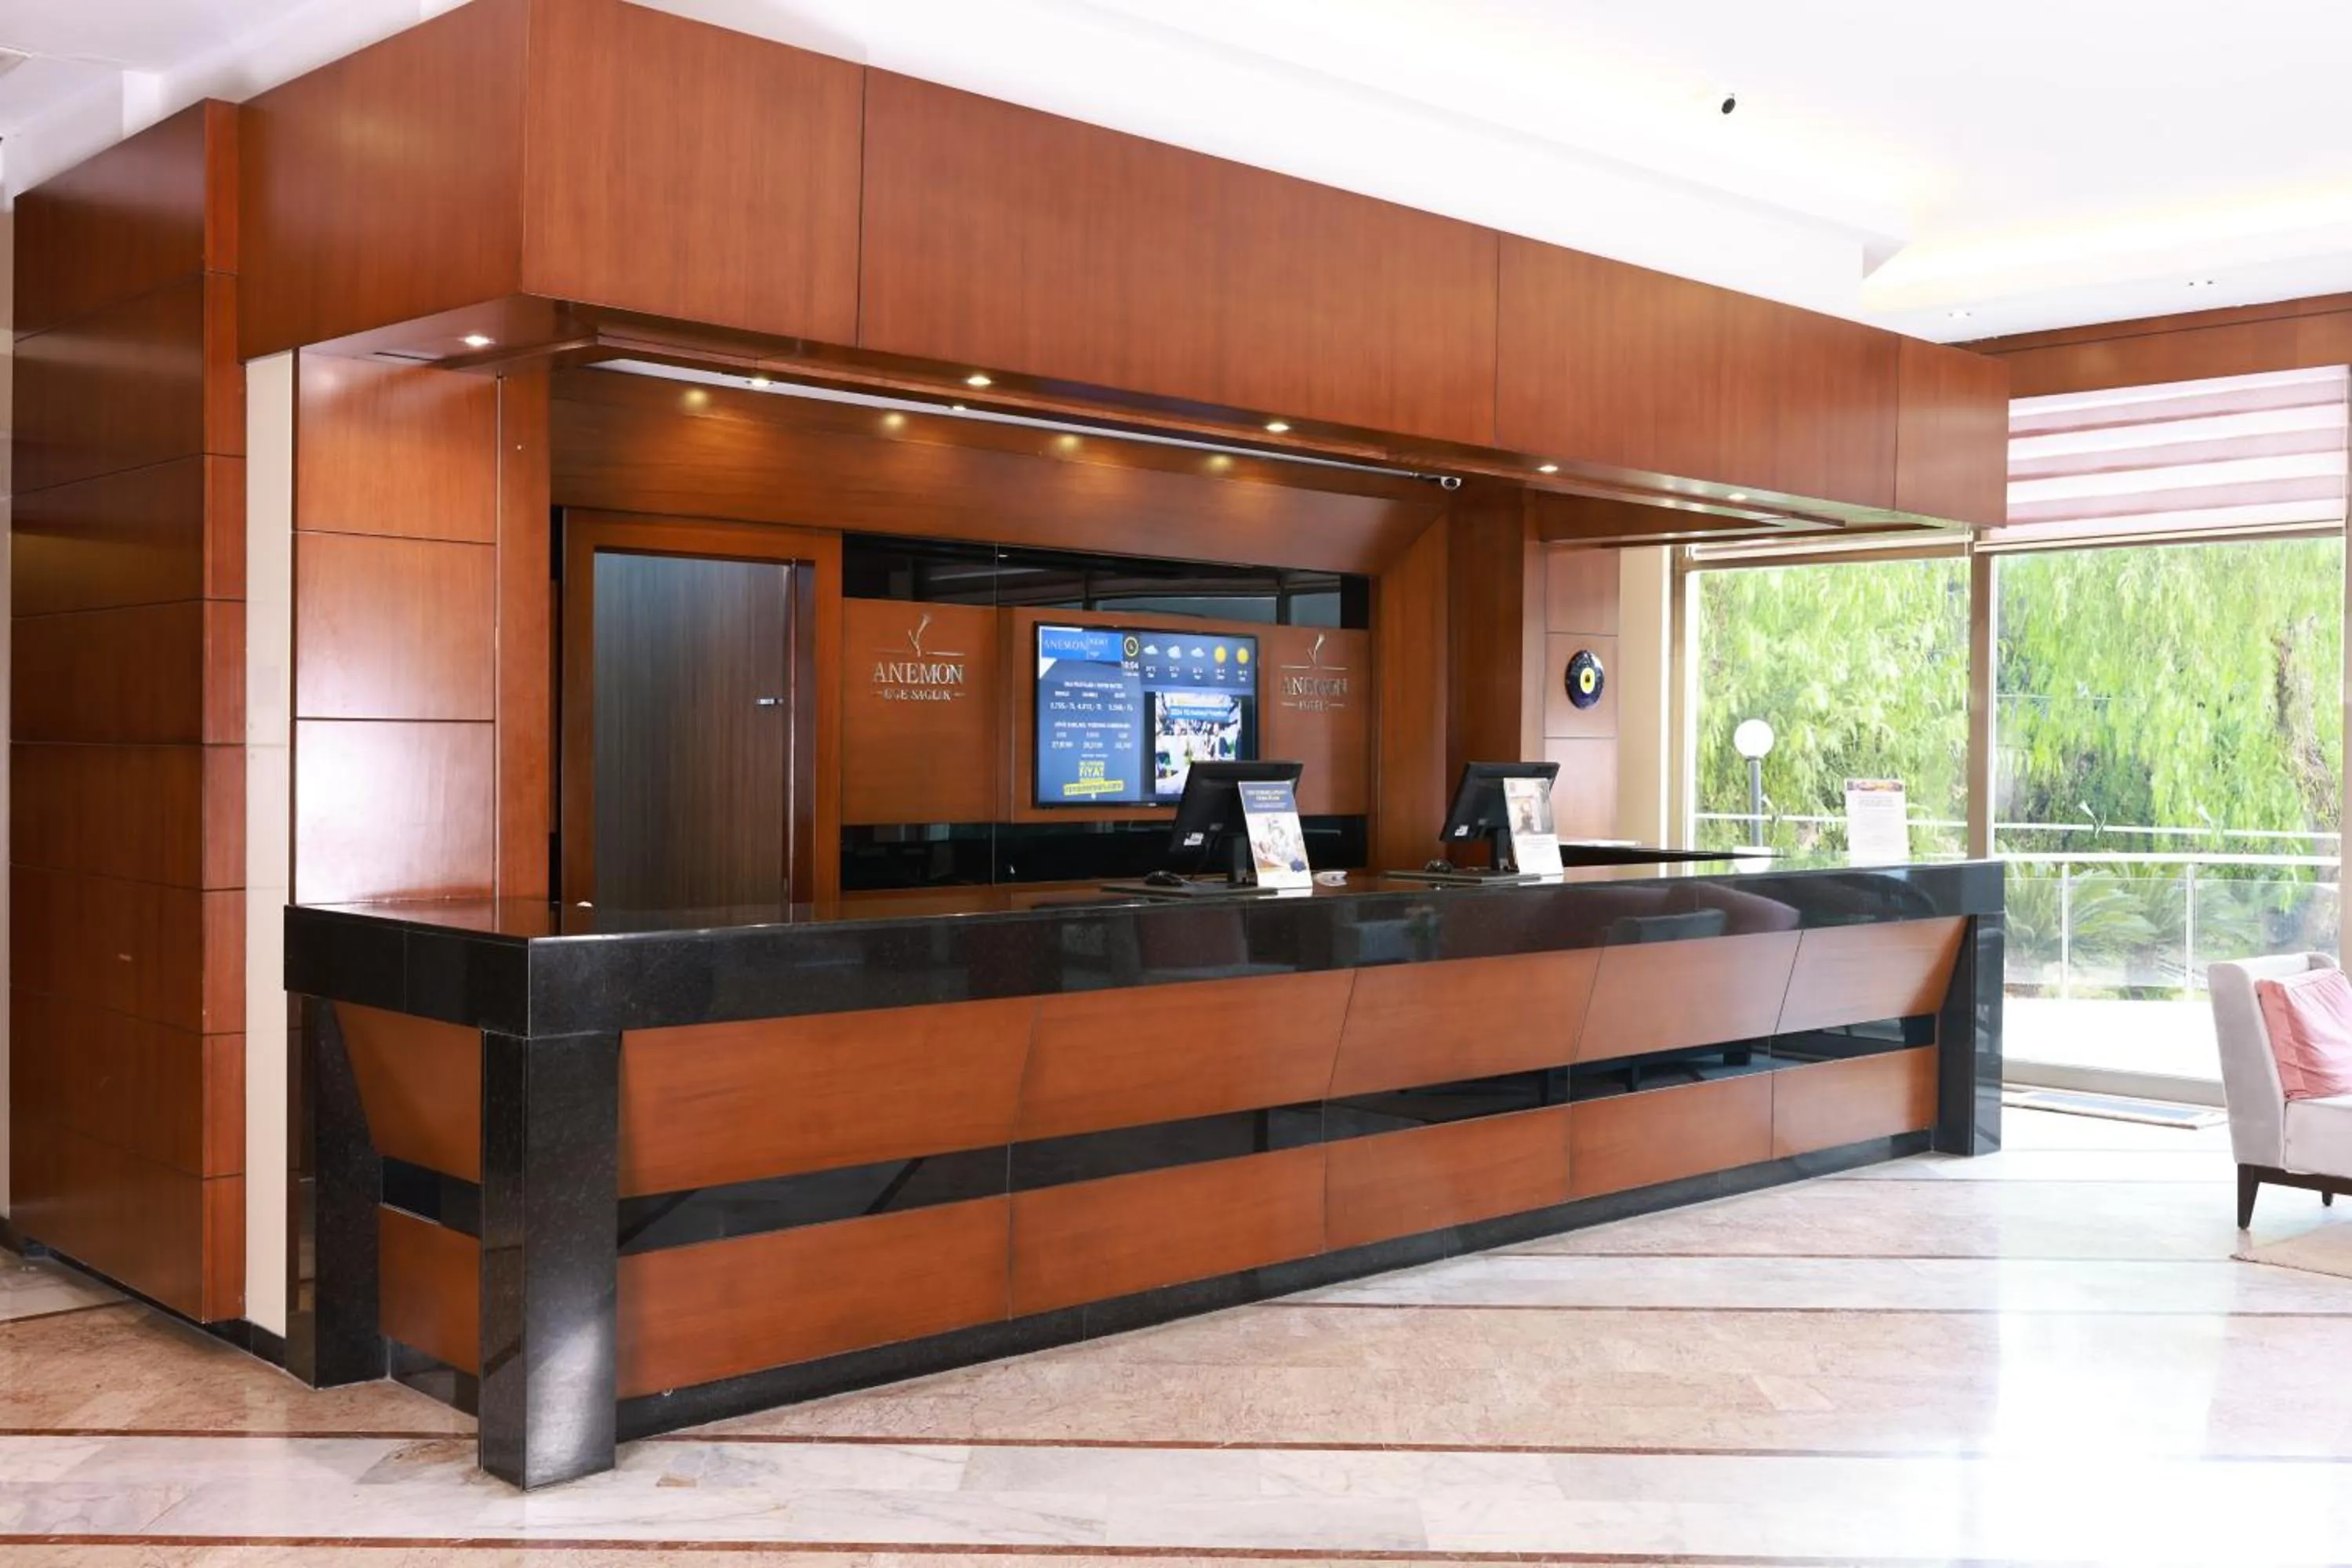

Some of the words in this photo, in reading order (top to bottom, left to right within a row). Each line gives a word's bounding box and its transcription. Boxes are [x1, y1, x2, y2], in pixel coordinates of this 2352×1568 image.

[1044, 637, 1087, 652] ANEMON
[873, 662, 964, 684] ANEMON
[1281, 676, 1348, 696] ANEMON
